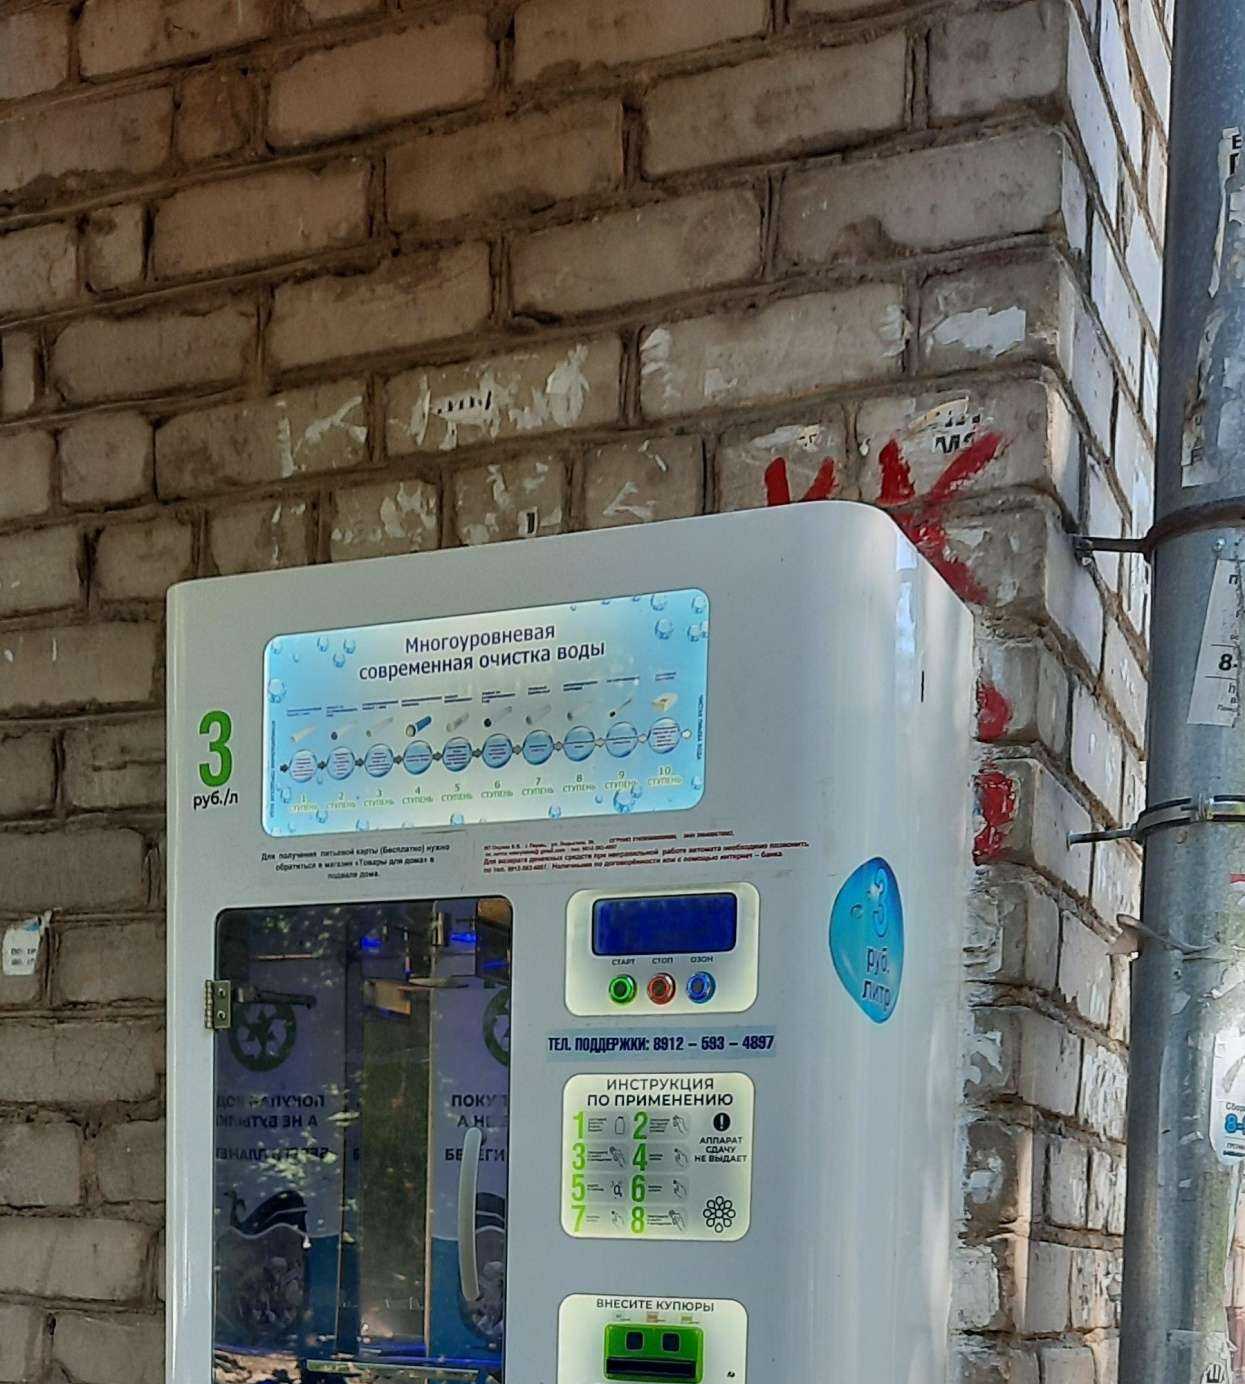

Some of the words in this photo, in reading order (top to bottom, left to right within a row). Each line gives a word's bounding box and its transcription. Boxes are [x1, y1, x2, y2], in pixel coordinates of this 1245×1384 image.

[405, 624, 556, 654] Многоуровневая
[359, 657, 473, 681] современная
[479, 648, 550, 667] очистка
[557, 641, 606, 661] воды
[199, 710, 232, 787] 3
[193, 788, 238, 811] руб./л
[611, 958, 635, 966] СТАРТ
[651, 957, 674, 965] СТОП
[690, 955, 714, 963] ОЗОН
[548, 1037, 571, 1051] ТЕЛ.
[575, 1037, 650, 1053] ПОДДЕРЖКИ:
[653, 1036, 684, 1051] 8912
[742, 1035, 775, 1050] 4897
[606, 1078, 714, 1092] ИНСТРУКЦИЯ
[587, 1095, 610, 1106] ПО
[615, 1094, 733, 1106] ПРИМЕНЕНИЮ
[572, 1111, 585, 1139] 1
[633, 1111, 648, 1140] 2
[699, 1136, 743, 1145] АППАРАТ
[705, 1145, 736, 1155] СДАЧУ
[445, 1148, 505, 1161] БЕЕГИ
[572, 1143, 586, 1170] 3
[632, 1143, 648, 1171] 4
[694, 1155, 707, 1163] НЕ
[571, 1174, 586, 1201] 5
[631, 1175, 646, 1202] 6
[571, 1205, 587, 1232] 7
[631, 1206, 645, 1233] 8
[596, 1299, 654, 1311] ВНЕСИТЕ
[656, 1301, 714, 1313] КУПЮРЫ
